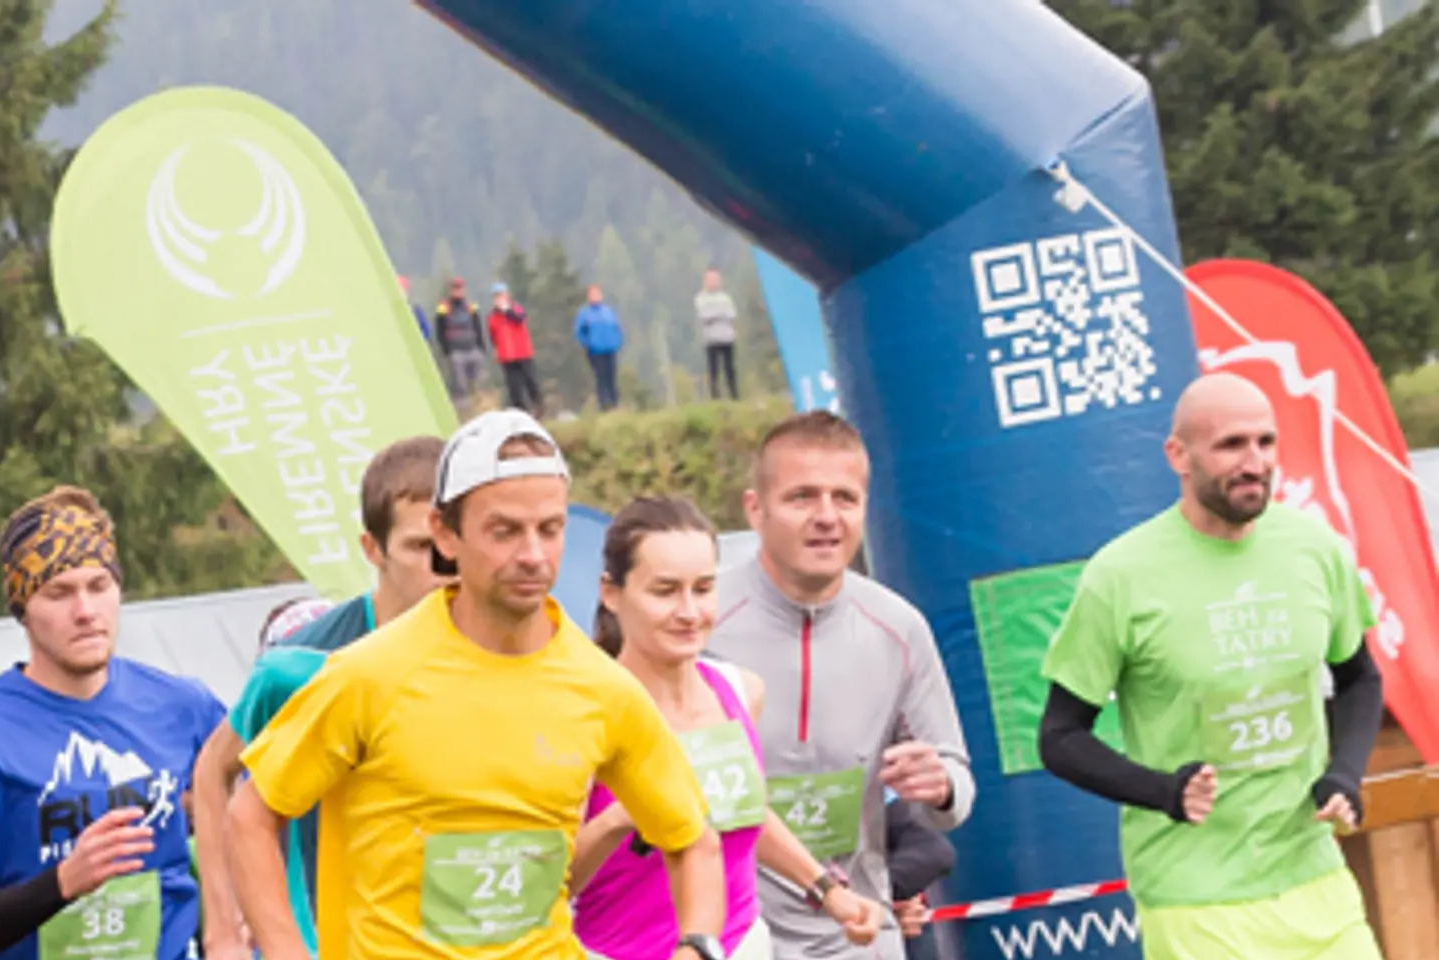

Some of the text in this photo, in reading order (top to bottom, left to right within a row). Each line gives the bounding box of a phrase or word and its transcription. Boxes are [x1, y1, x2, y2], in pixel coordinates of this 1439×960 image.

[1229, 711, 1293, 751] 236
[703, 764, 749, 800] 42
[785, 799, 828, 825] 42
[472, 865, 522, 898] 24
[82, 907, 125, 940] 38
